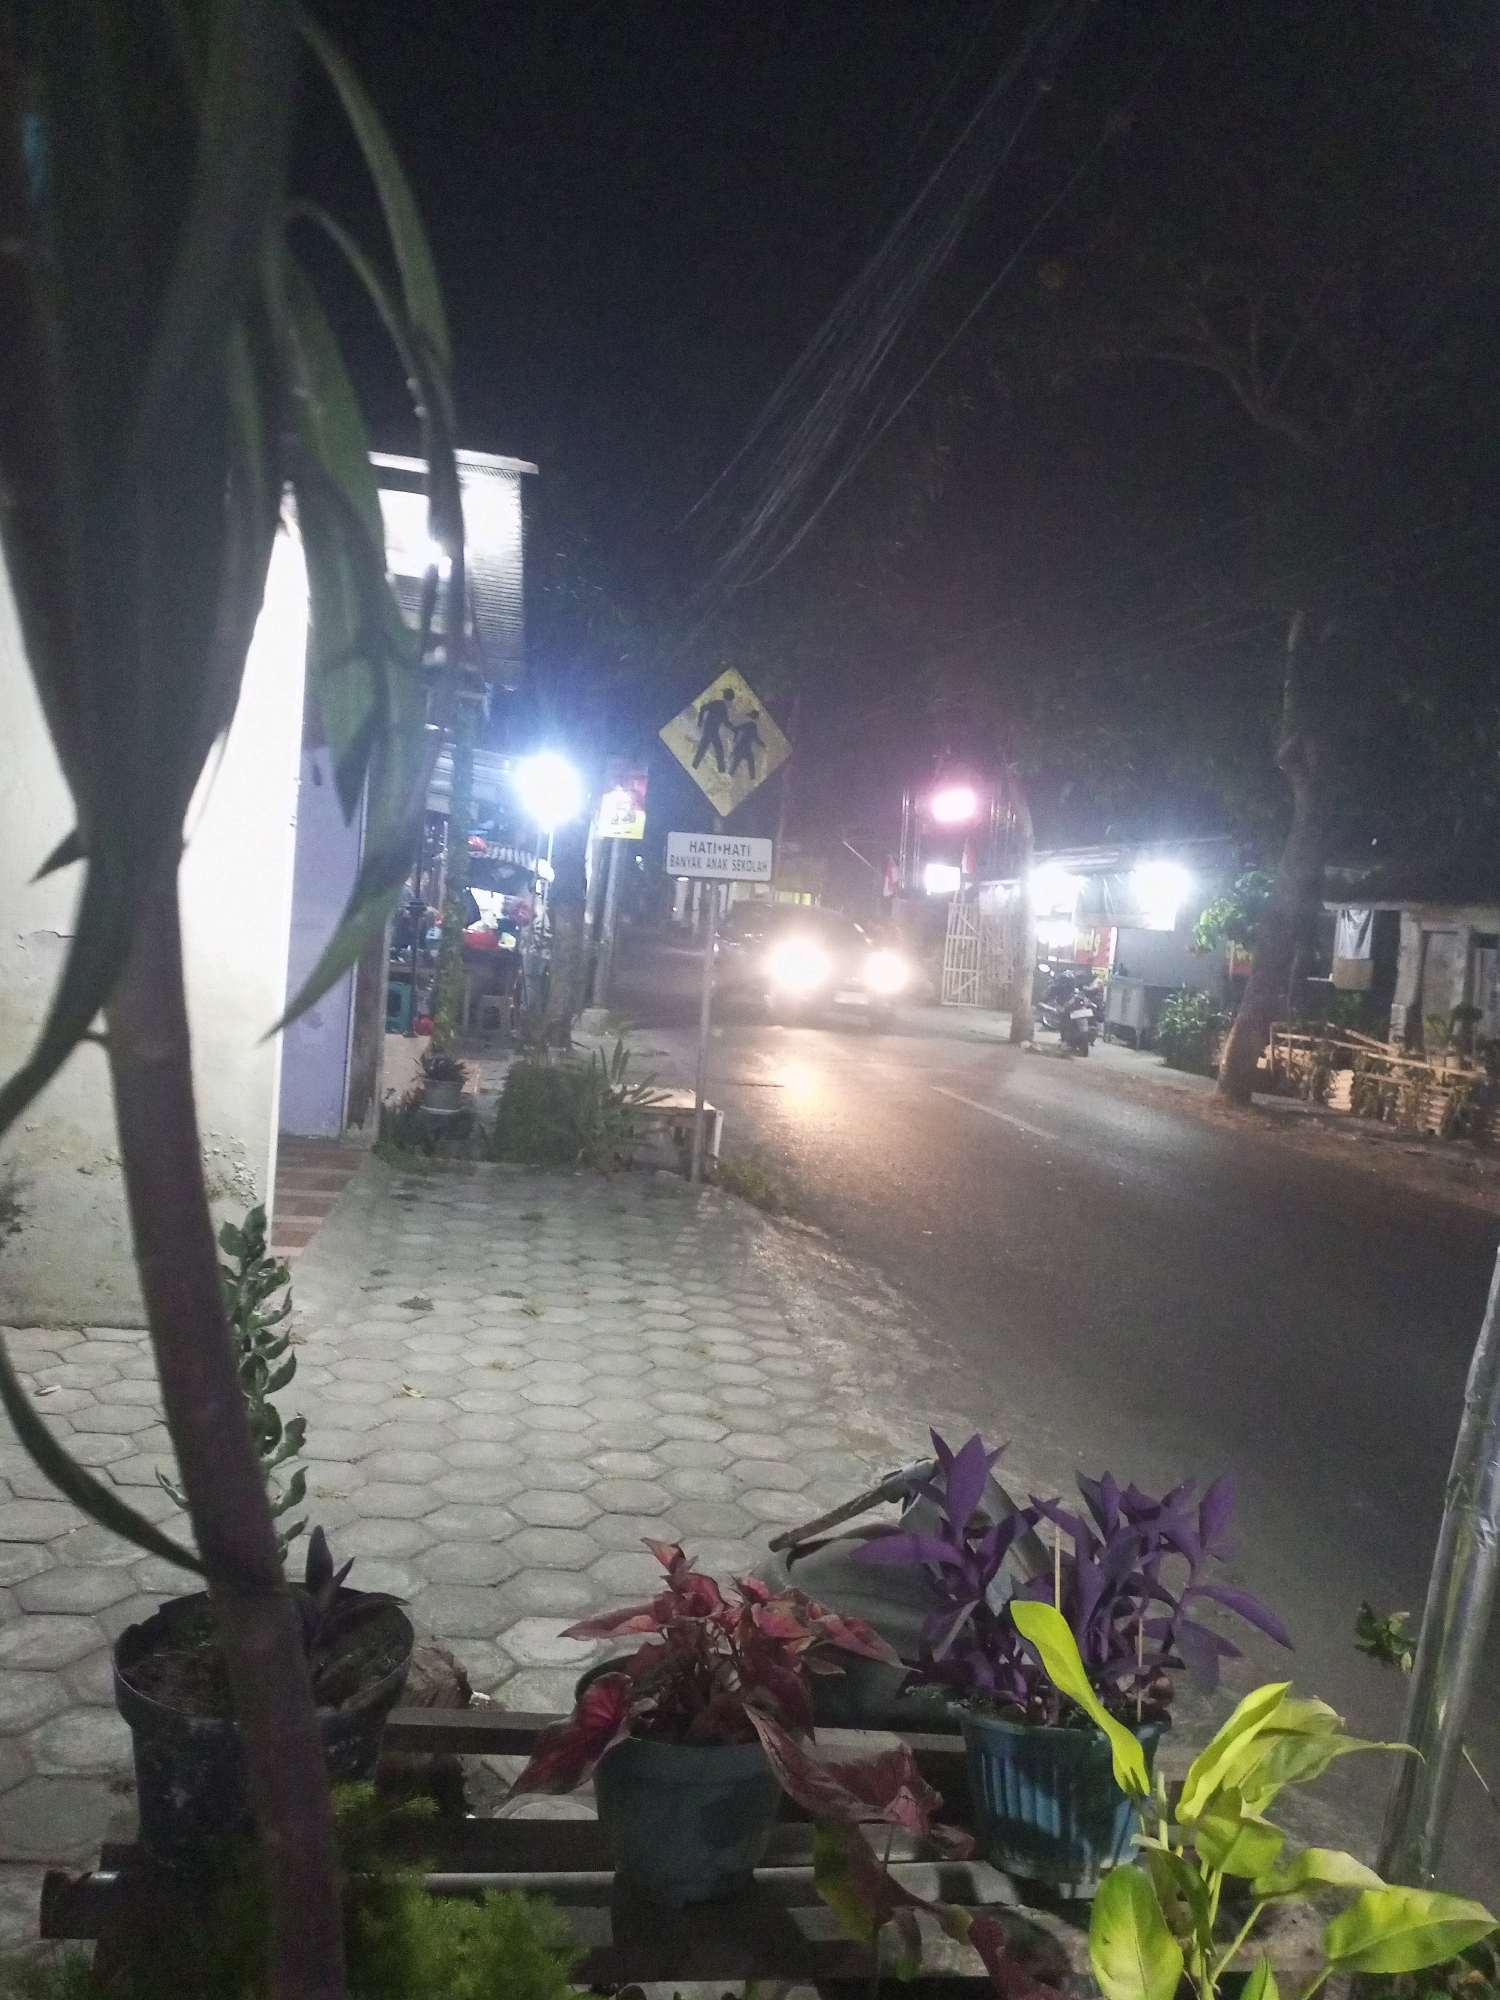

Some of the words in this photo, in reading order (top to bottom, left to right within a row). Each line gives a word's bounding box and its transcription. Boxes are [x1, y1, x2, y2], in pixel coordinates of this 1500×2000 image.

[669, 854, 702, 869] BANYAK
[706, 858, 728, 871] ANAK
[732, 859, 768, 873] SEKOLAH
